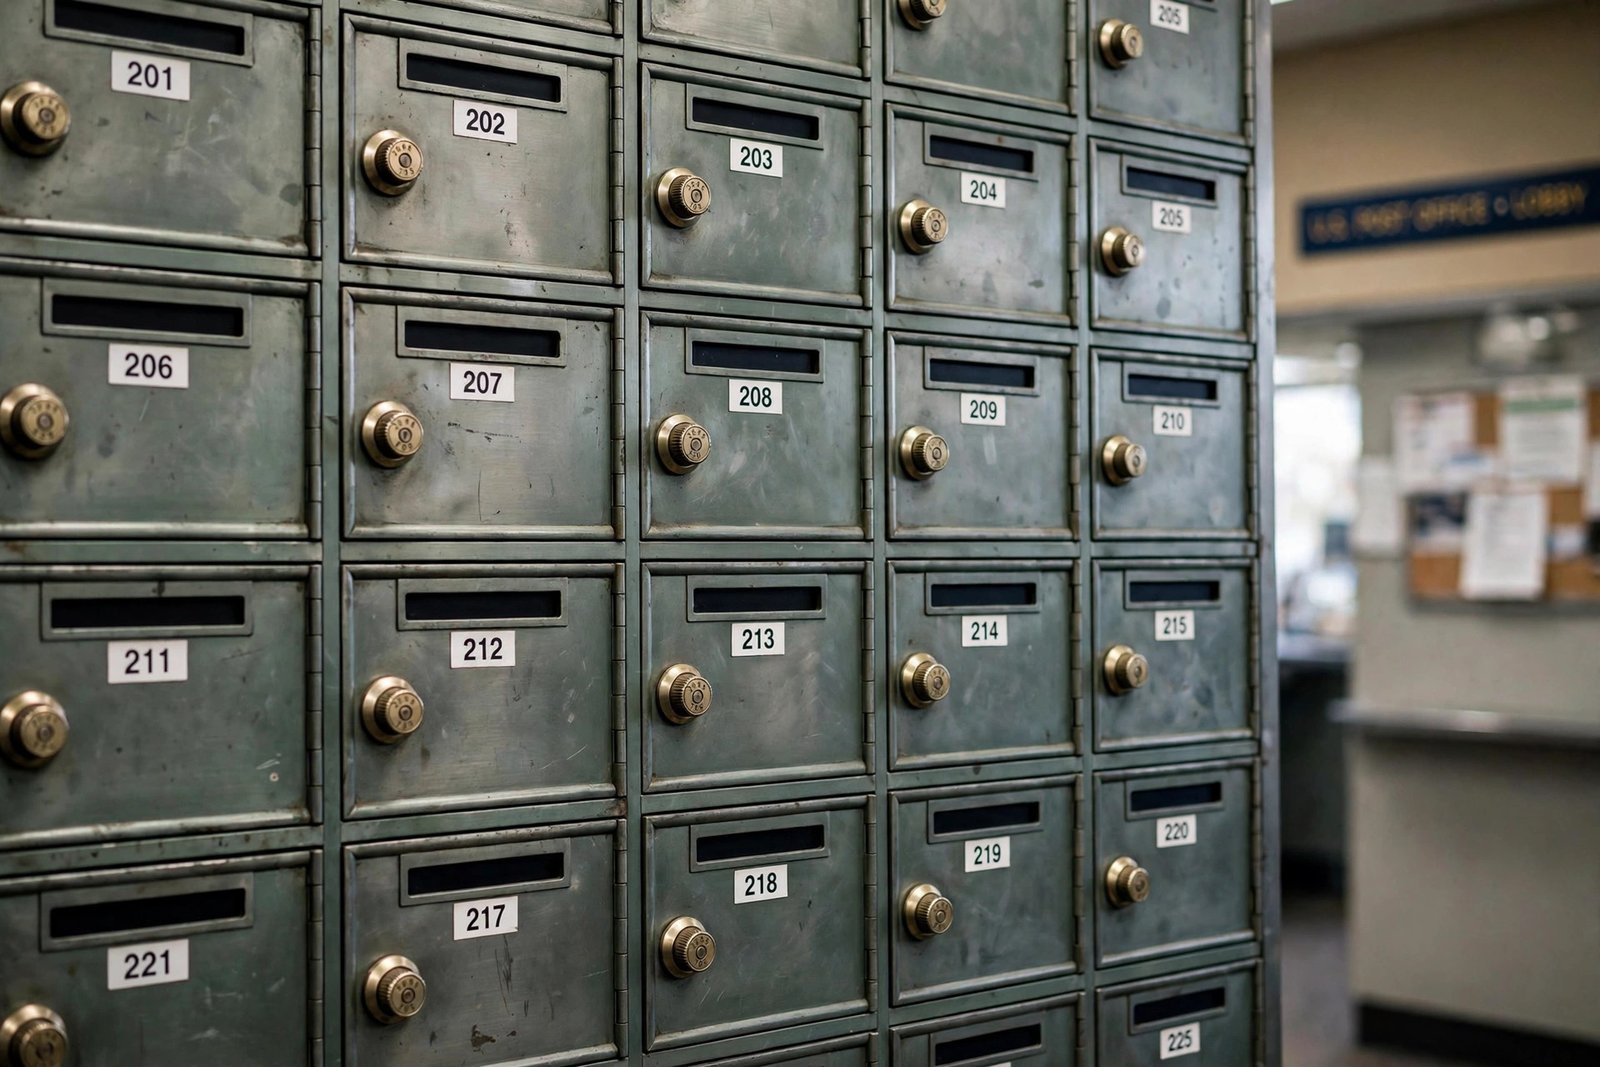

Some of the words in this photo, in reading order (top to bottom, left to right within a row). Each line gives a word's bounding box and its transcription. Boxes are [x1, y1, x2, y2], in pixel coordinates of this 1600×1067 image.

[128, 60, 172, 91] 201
[466, 108, 504, 136] 202
[740, 145, 772, 170] 203
[970, 179, 998, 201] 204
[1160, 207, 1184, 227] 205
[1413, 191, 1489, 231] OFFICE
[125, 352, 172, 380] 206
[464, 370, 503, 395] 207
[740, 385, 773, 408] 208
[970, 399, 998, 420] 209
[1161, 411, 1184, 431] 210
[971, 621, 998, 641] 214
[1164, 615, 1187, 635] 215
[464, 636, 503, 661] 212
[743, 628, 774, 650] 213
[124, 648, 169, 675] 211
[1165, 820, 1189, 842] 220
[974, 843, 1000, 866] 219
[744, 872, 777, 897] 218
[467, 903, 505, 932] 217
[125, 949, 170, 980] 221
[1169, 1029, 1192, 1052] 225
